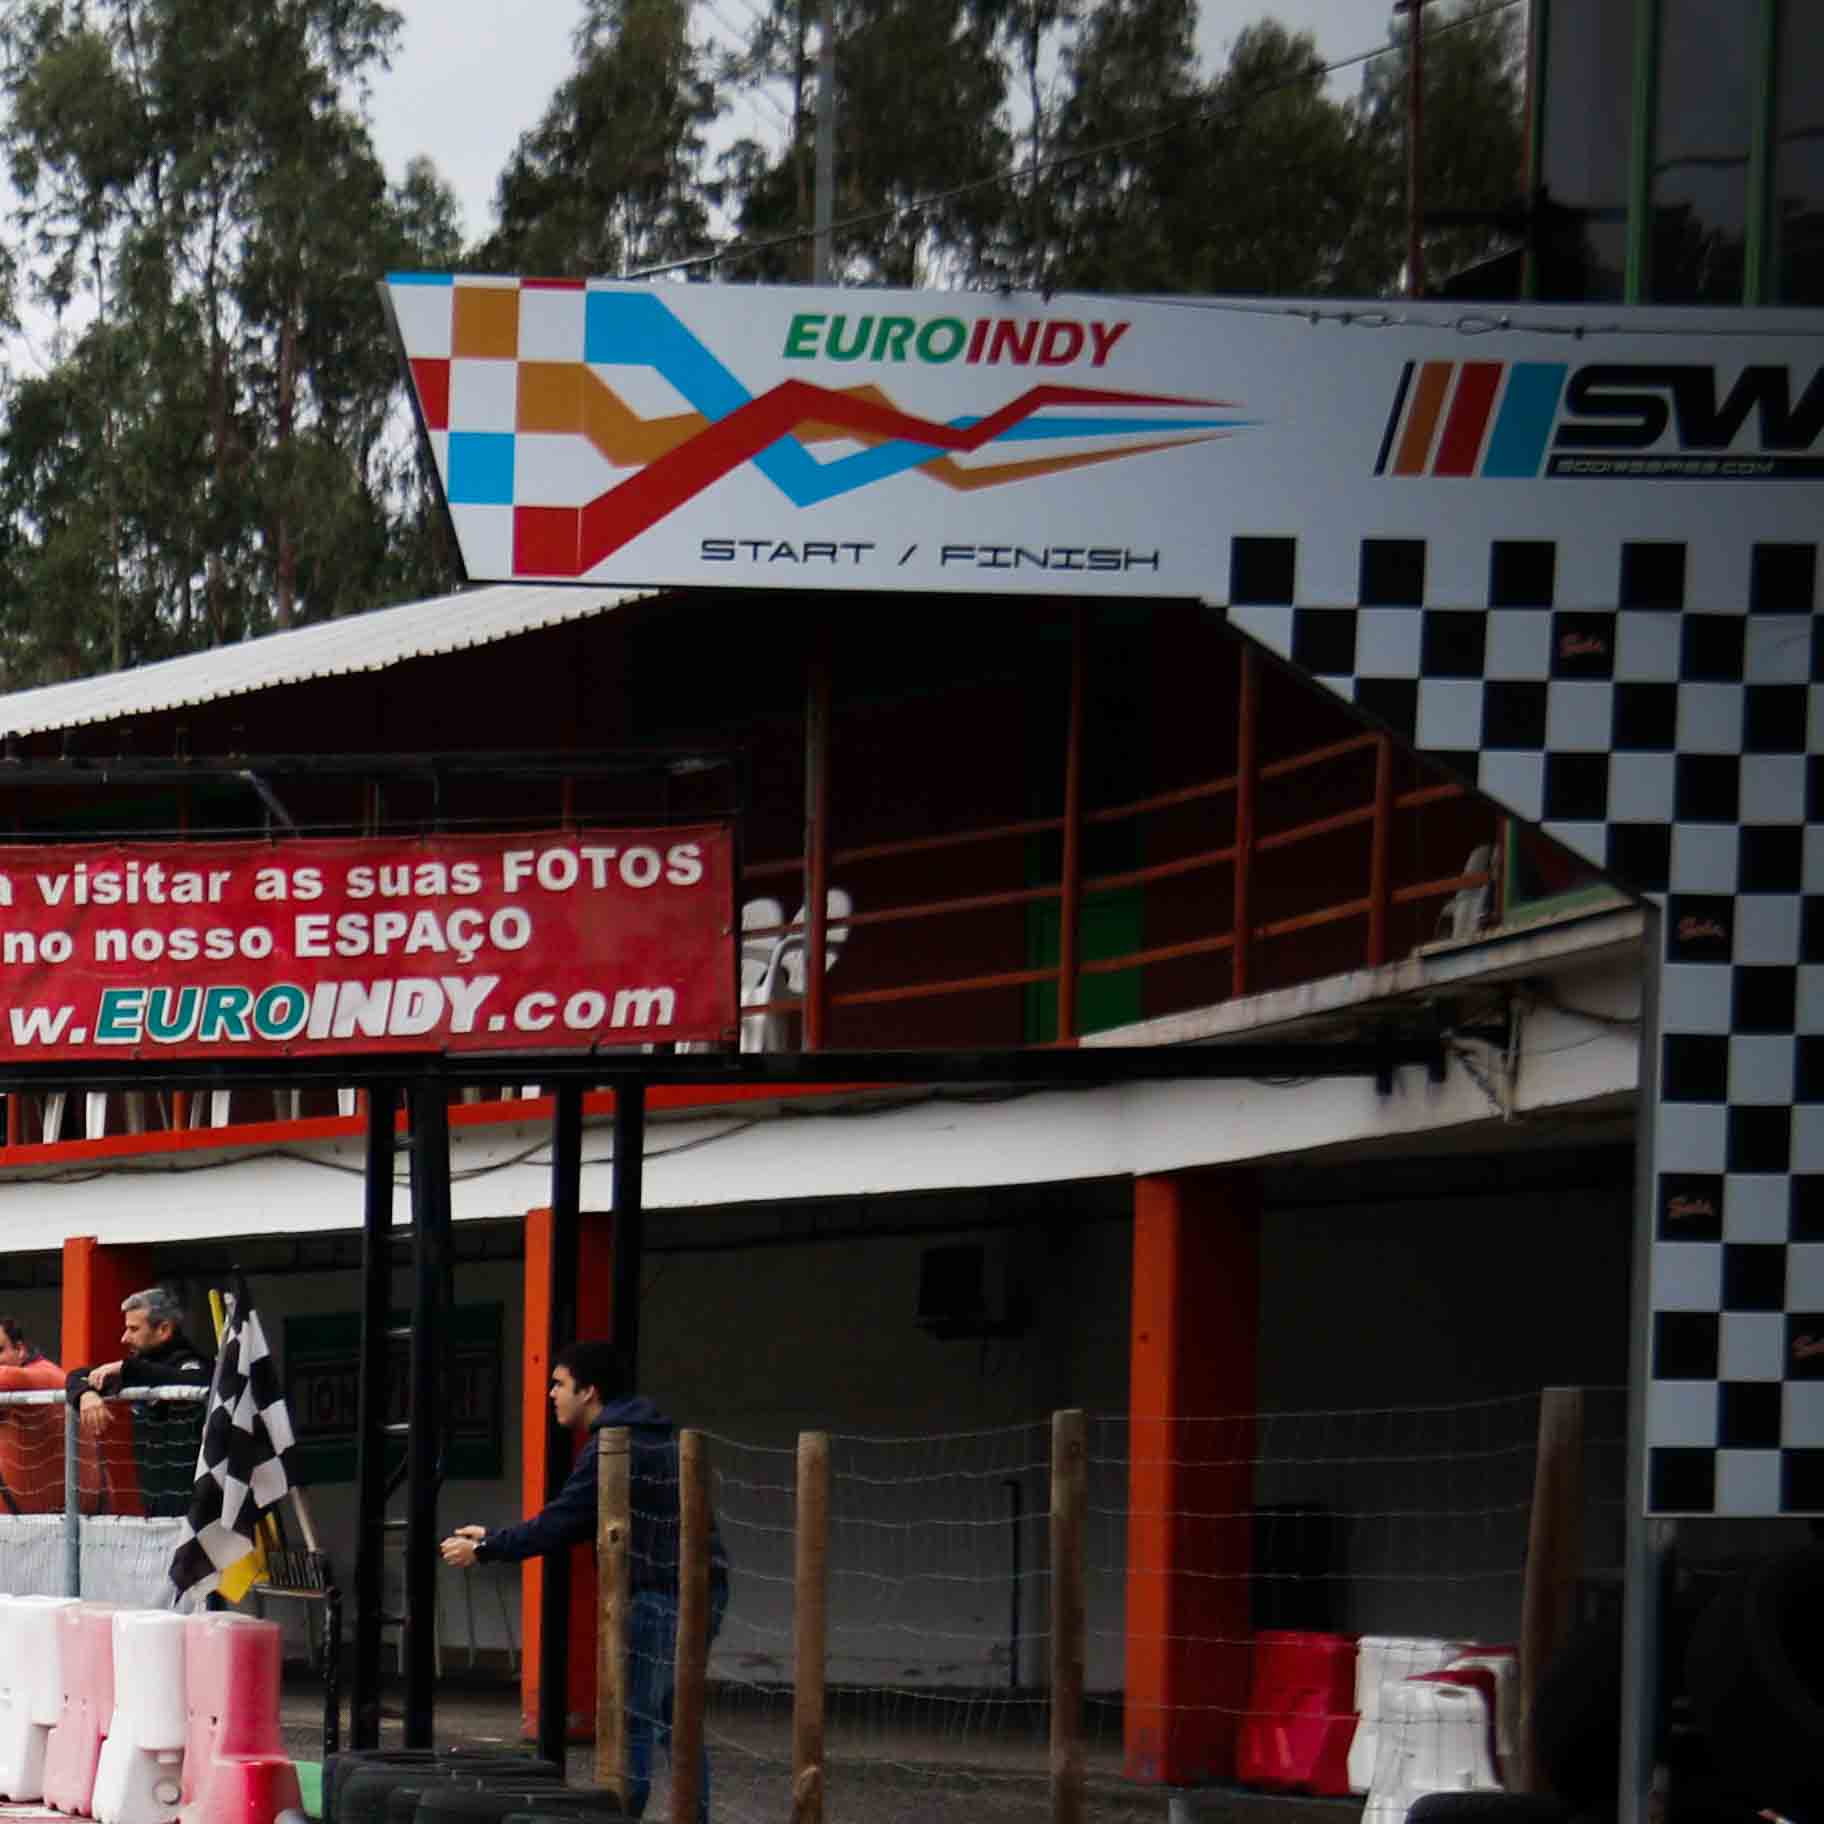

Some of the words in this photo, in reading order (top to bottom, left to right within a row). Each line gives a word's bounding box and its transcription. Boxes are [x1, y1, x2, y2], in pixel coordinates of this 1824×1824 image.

[783, 314, 1131, 367] EUROINDY
[699, 539, 876, 565] START
[897, 544, 918, 566] /
[940, 545, 1160, 571] FINISH
[36, 861, 232, 906] visitar
[254, 866, 324, 900] as
[346, 860, 482, 898] suas
[501, 842, 704, 894] FOTOS
[2, 930, 73, 965] no
[94, 926, 273, 962] nosso
[294, 907, 532, 963] ESPAÇO
